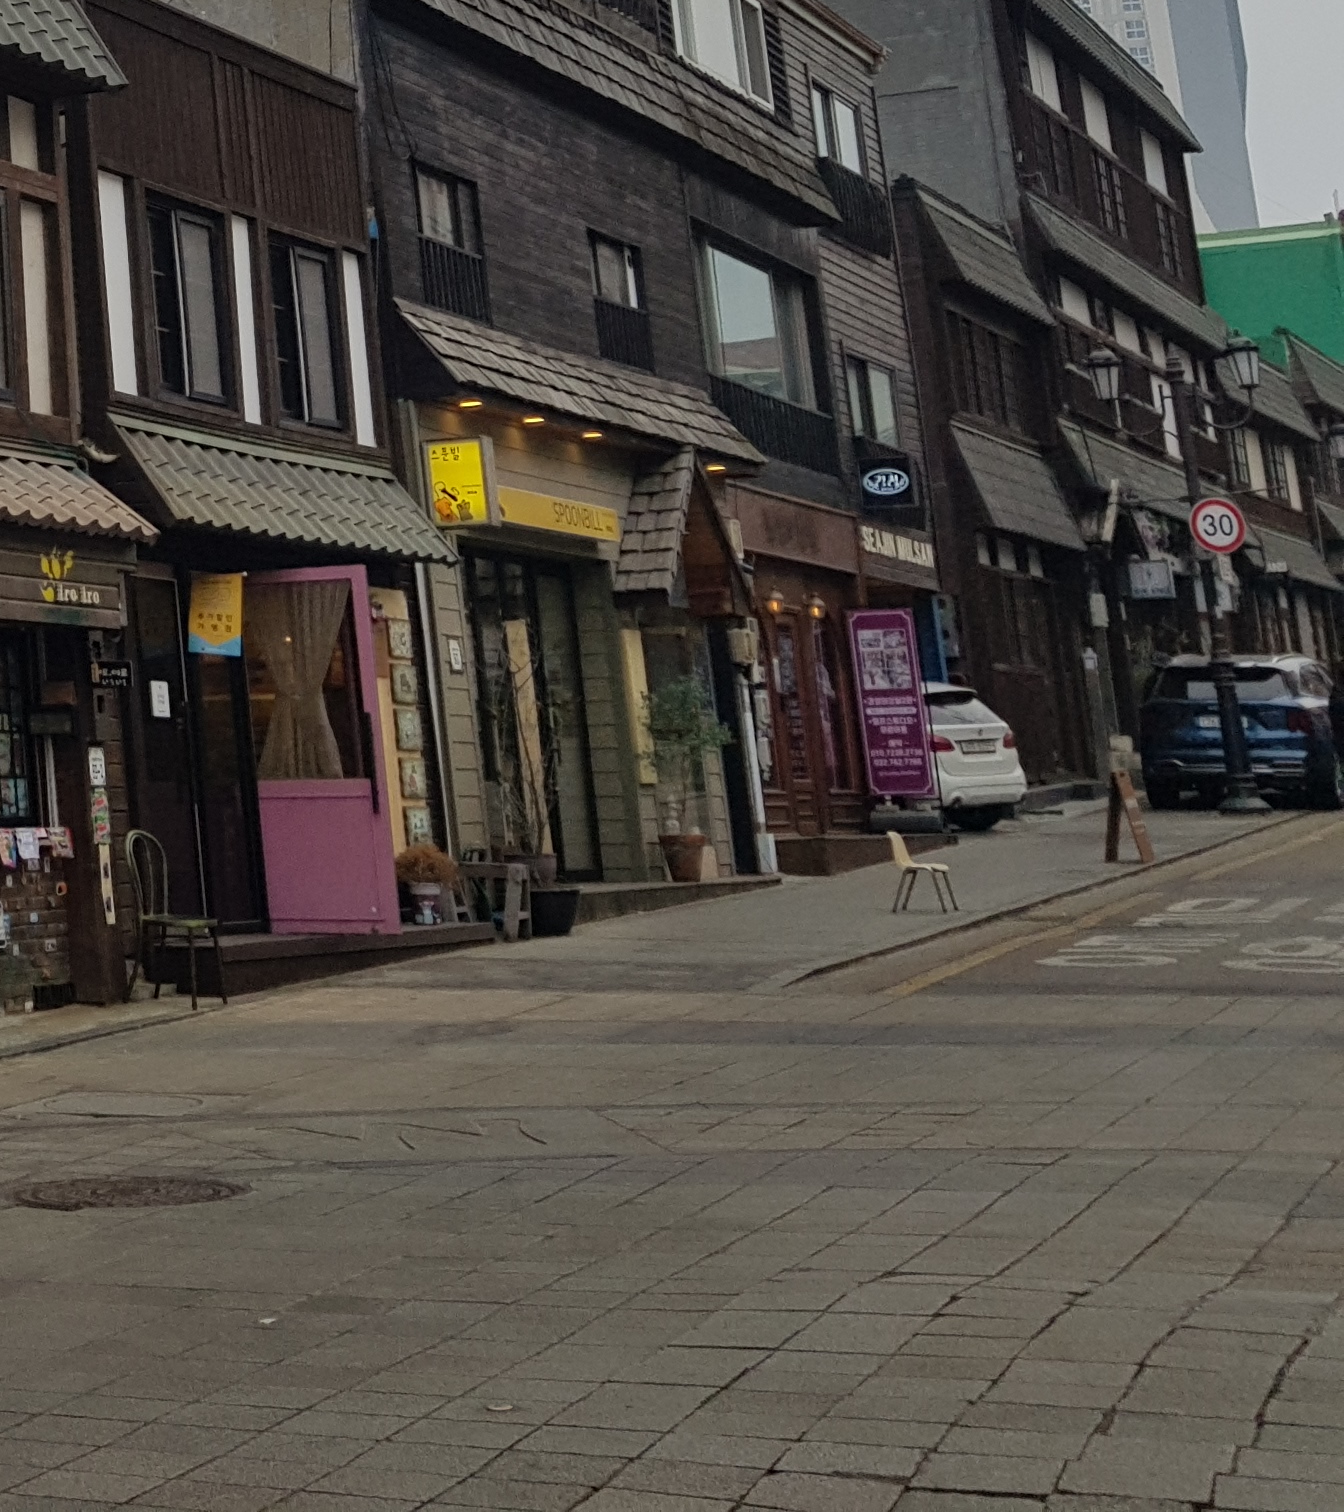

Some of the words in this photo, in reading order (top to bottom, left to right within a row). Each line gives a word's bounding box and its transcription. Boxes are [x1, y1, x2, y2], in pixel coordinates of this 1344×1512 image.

[430, 446, 461, 462] 스푼빌
[552, 501, 604, 532] SPOONBILL
[1202, 514, 1234, 537] 30
